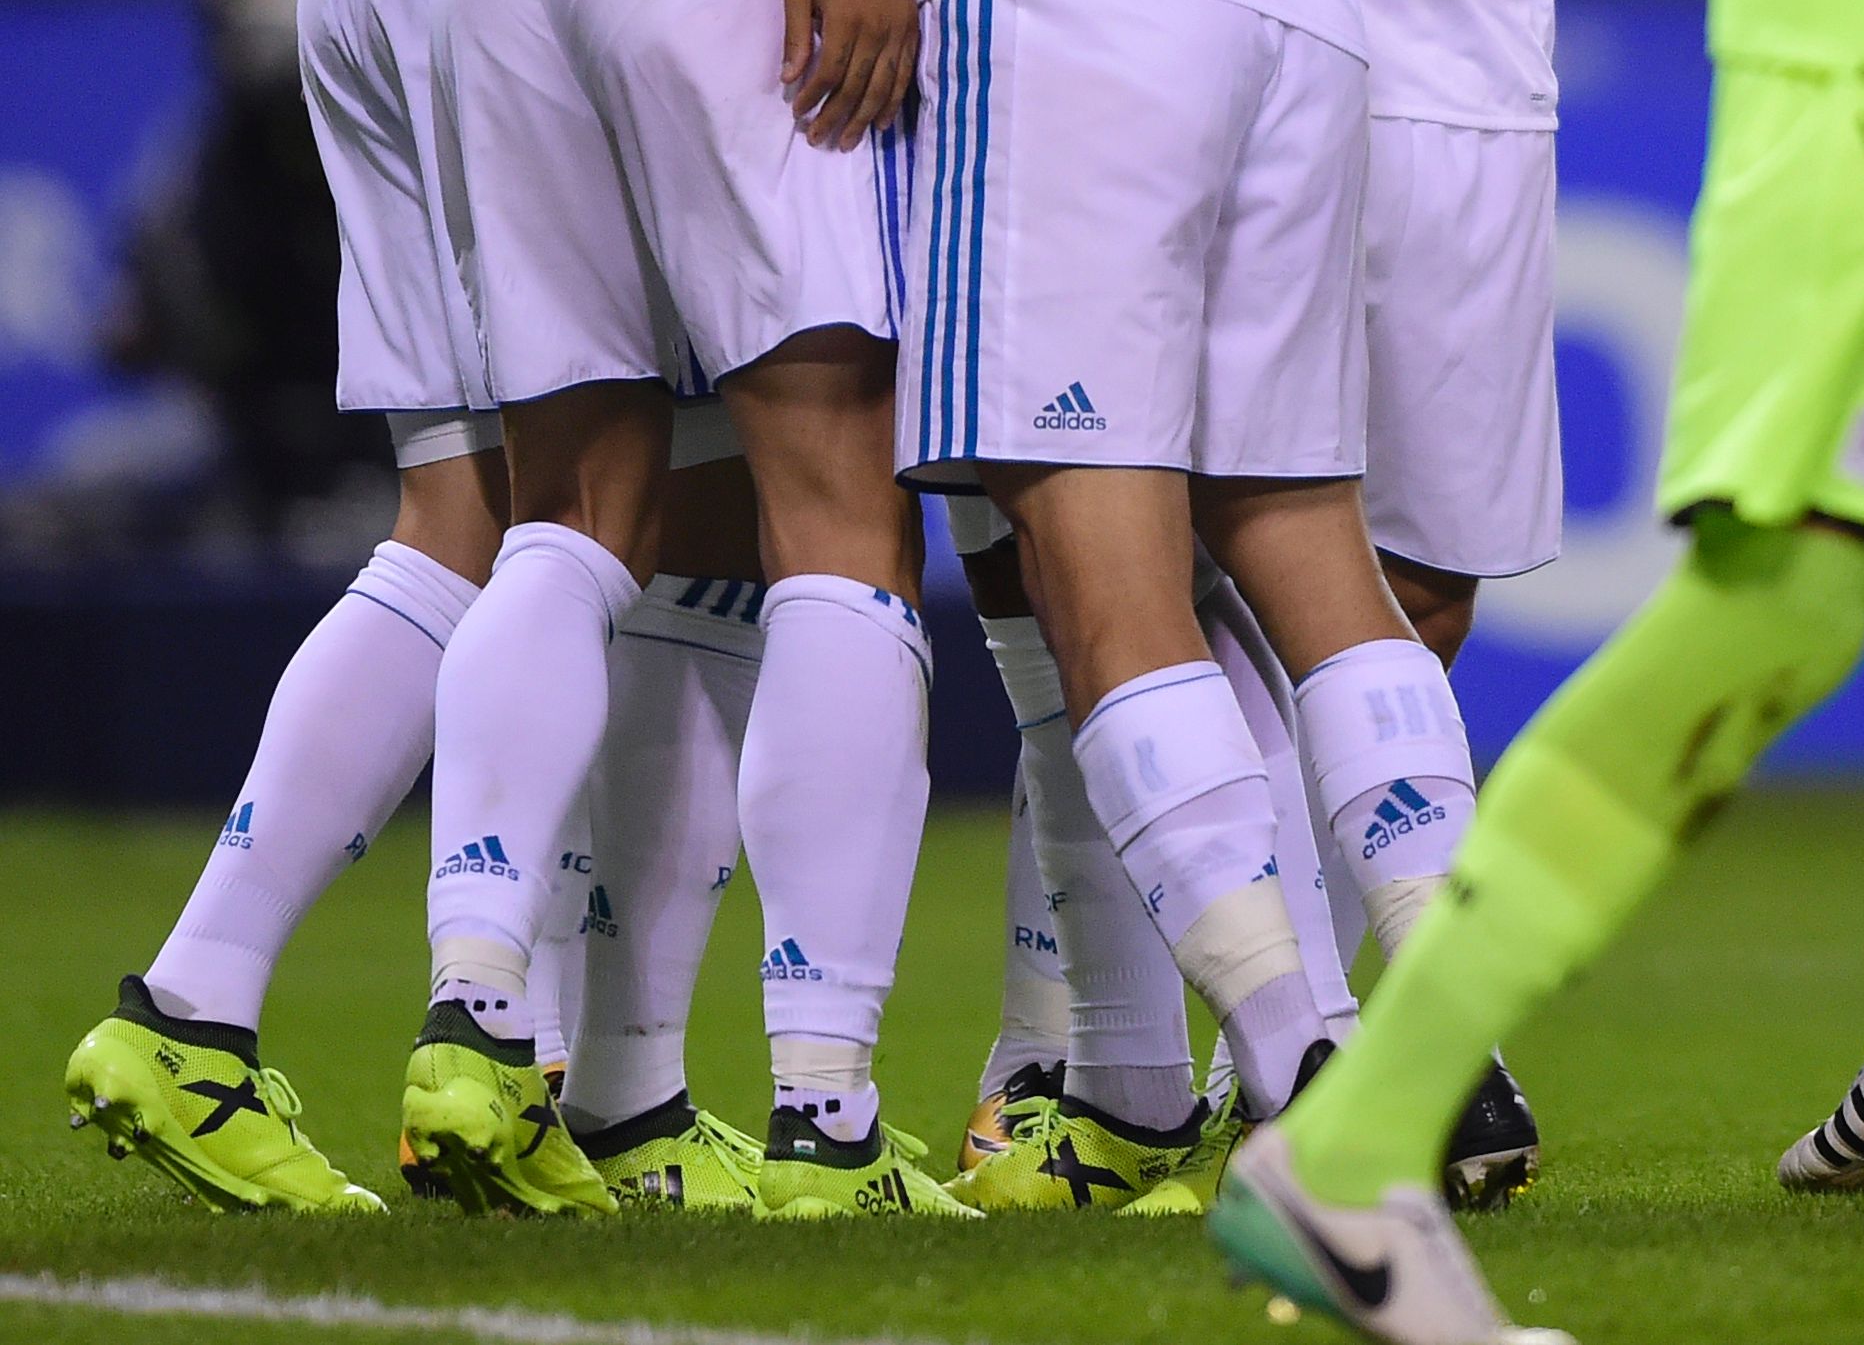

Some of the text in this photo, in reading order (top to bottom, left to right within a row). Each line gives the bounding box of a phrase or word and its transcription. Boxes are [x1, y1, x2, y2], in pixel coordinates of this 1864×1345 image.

[1033, 411, 1107, 431] adidas
[1362, 805, 1447, 860] adidas
[435, 857, 521, 882] adidas
